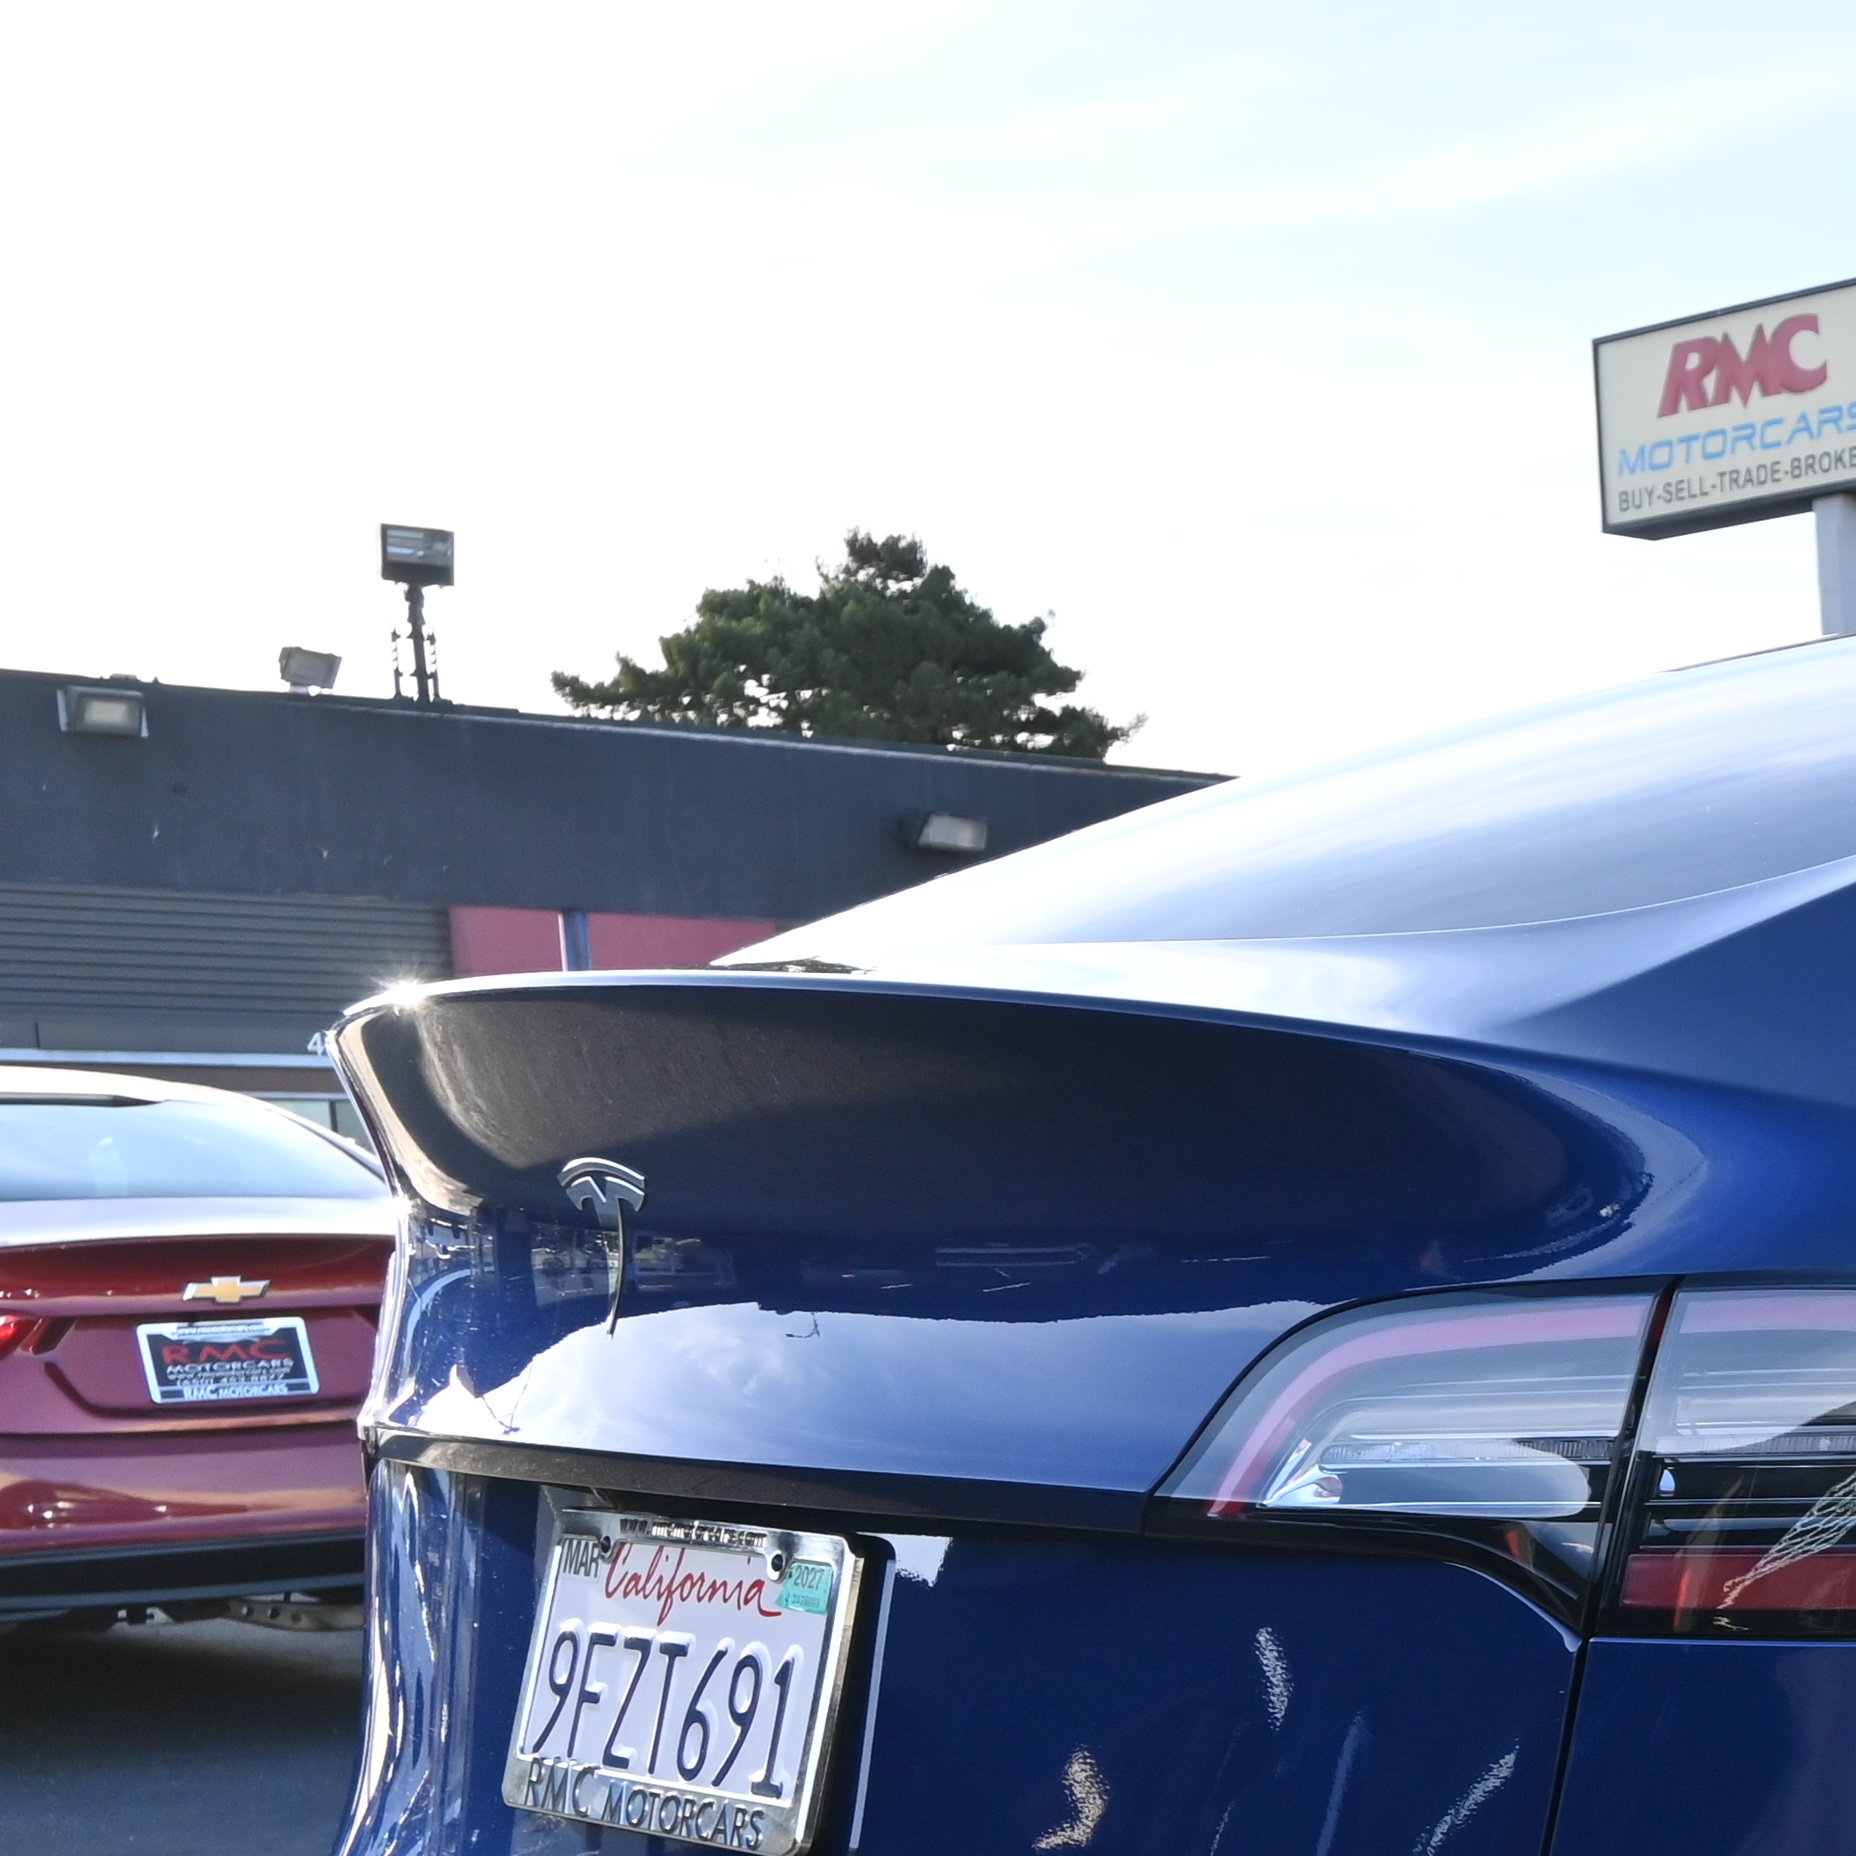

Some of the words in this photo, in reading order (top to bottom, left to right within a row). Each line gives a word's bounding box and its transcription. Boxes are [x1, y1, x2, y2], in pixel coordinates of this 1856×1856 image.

[1657, 312, 1828, 418] RMC
[162, 1338, 292, 1365] RMC
[562, 1537, 600, 1578] MAR
[604, 1541, 782, 1627] California
[793, 1564, 825, 1590] 2027
[532, 1629, 796, 1799] 9FZT691
[524, 1756, 596, 1818] RMC
[601, 1779, 765, 1850] MOTORCARS
